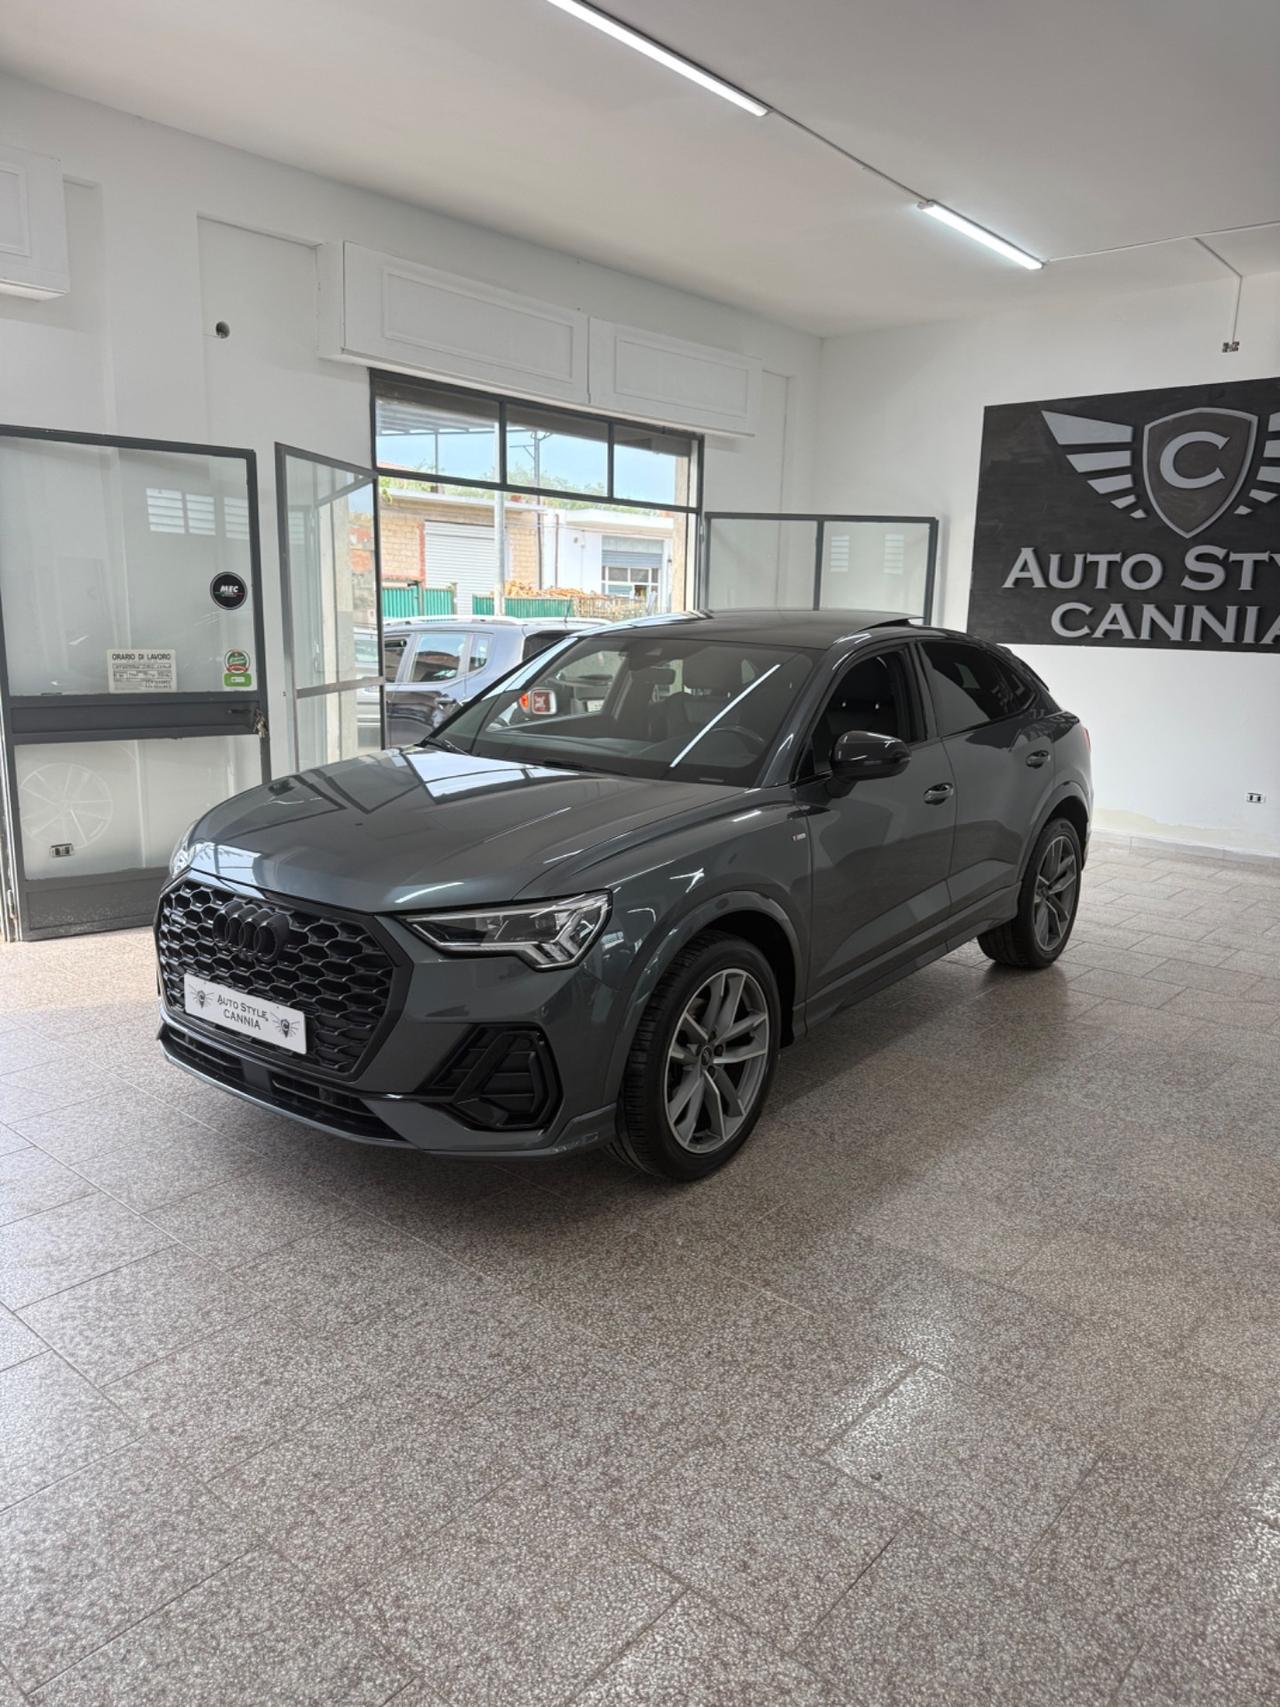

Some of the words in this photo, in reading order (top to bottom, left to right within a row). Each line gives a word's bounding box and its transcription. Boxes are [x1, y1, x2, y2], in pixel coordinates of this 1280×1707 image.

[1159, 431, 1230, 489] C
[1002, 547, 1163, 591] AUTO
[1181, 545, 1280, 592] ST
[112, 653, 135, 661] ORARIO
[147, 653, 171, 661] LAVORO
[217, 994, 239, 1009] AUTO
[240, 1002, 268, 1019] STYLE
[223, 1008, 262, 1031] CANNIA
